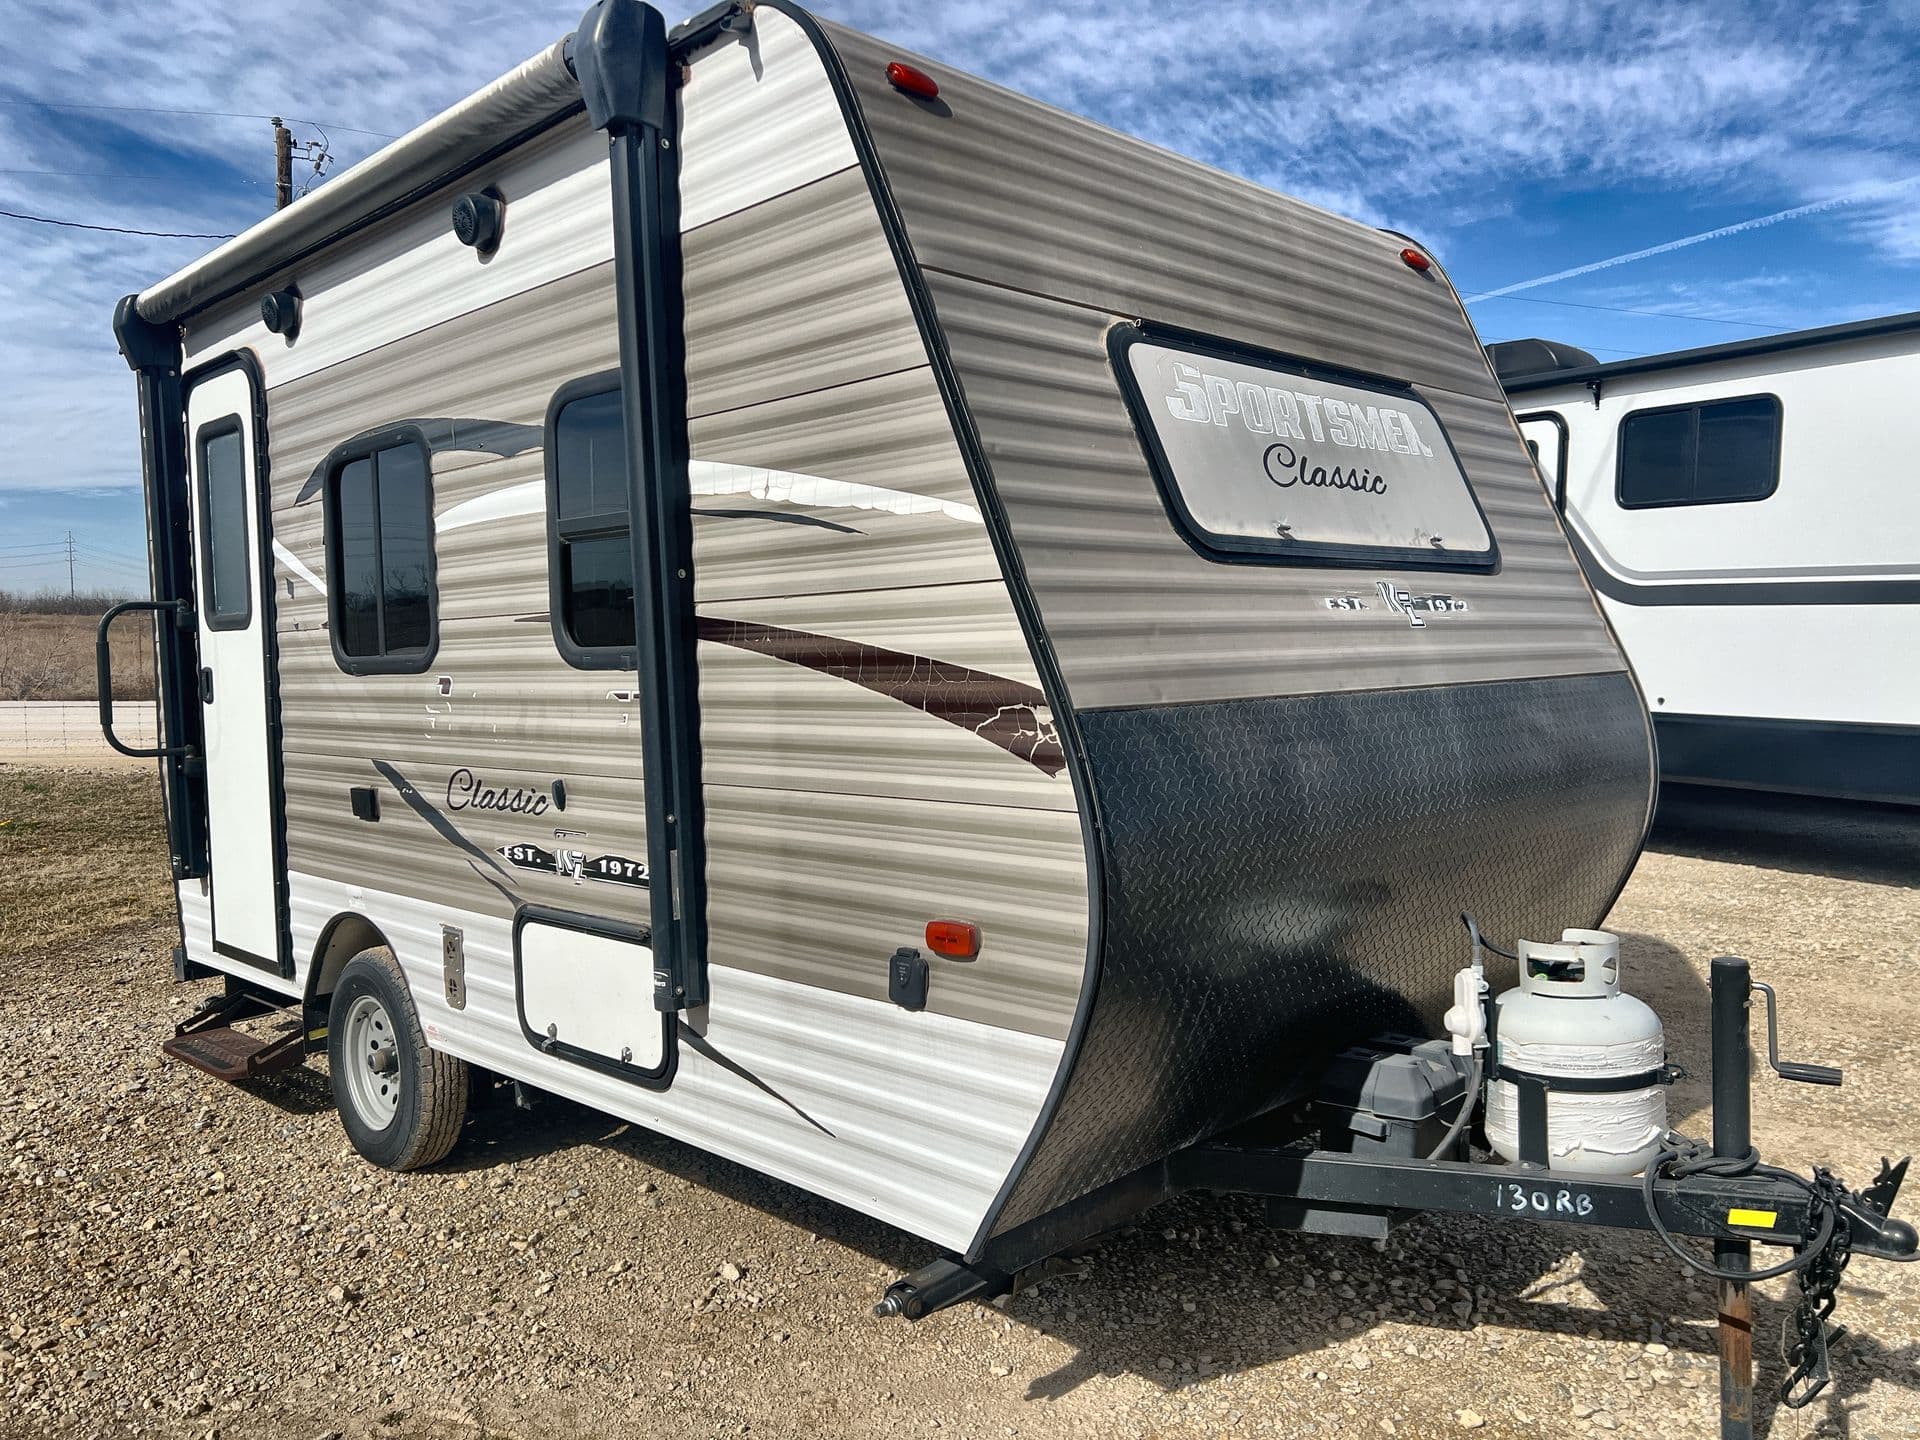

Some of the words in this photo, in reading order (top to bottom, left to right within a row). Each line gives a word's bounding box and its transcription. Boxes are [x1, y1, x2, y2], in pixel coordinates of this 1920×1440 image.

[1262, 442, 1388, 495] Classic
[446, 768, 549, 816] Classic
[503, 846, 542, 863] EST.
[599, 858, 650, 881] 1972
[1497, 1183, 1594, 1216] 130RB
